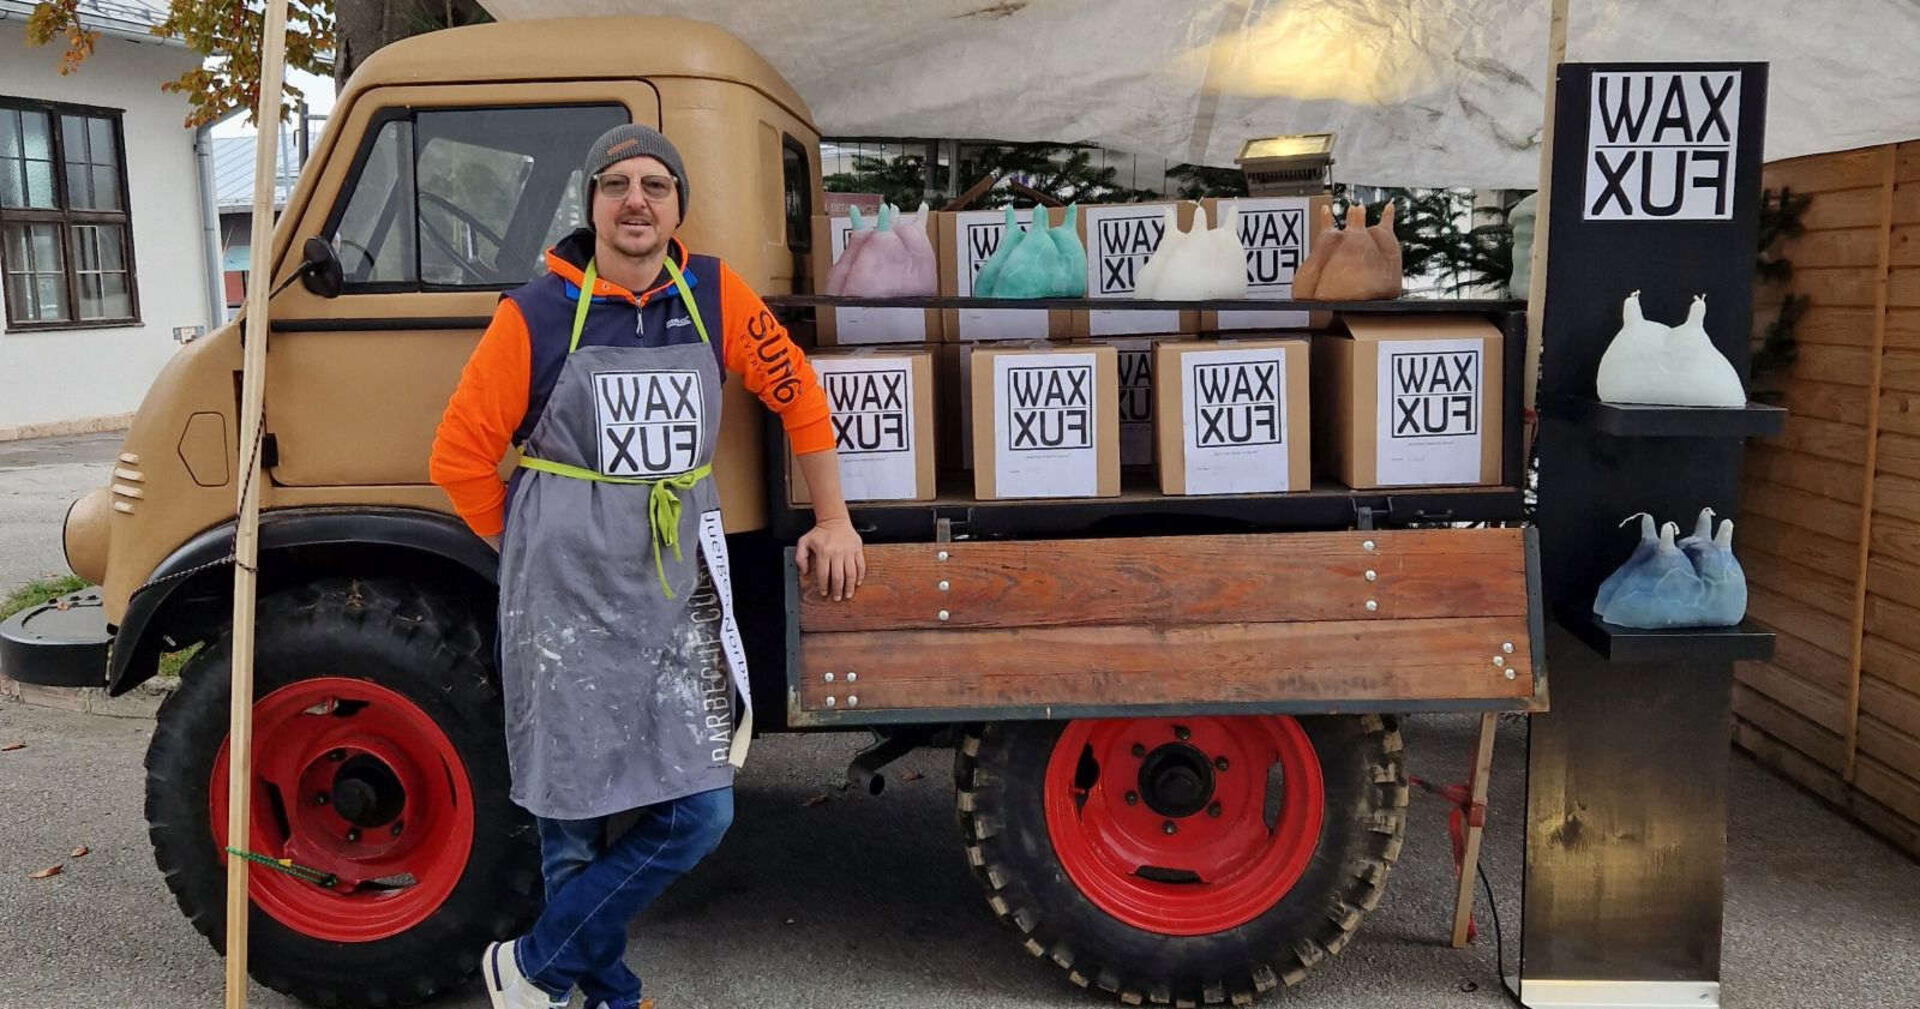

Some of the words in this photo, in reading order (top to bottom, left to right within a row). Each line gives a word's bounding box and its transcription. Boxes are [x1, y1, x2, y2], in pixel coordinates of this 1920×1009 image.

[1598, 75, 1734, 143] WAX
[830, 374, 903, 411] WAX
[1013, 370, 1087, 408] WAX
[1200, 364, 1275, 403] WAX
[1397, 355, 1472, 394] WAX
[601, 375, 697, 422] WAX
